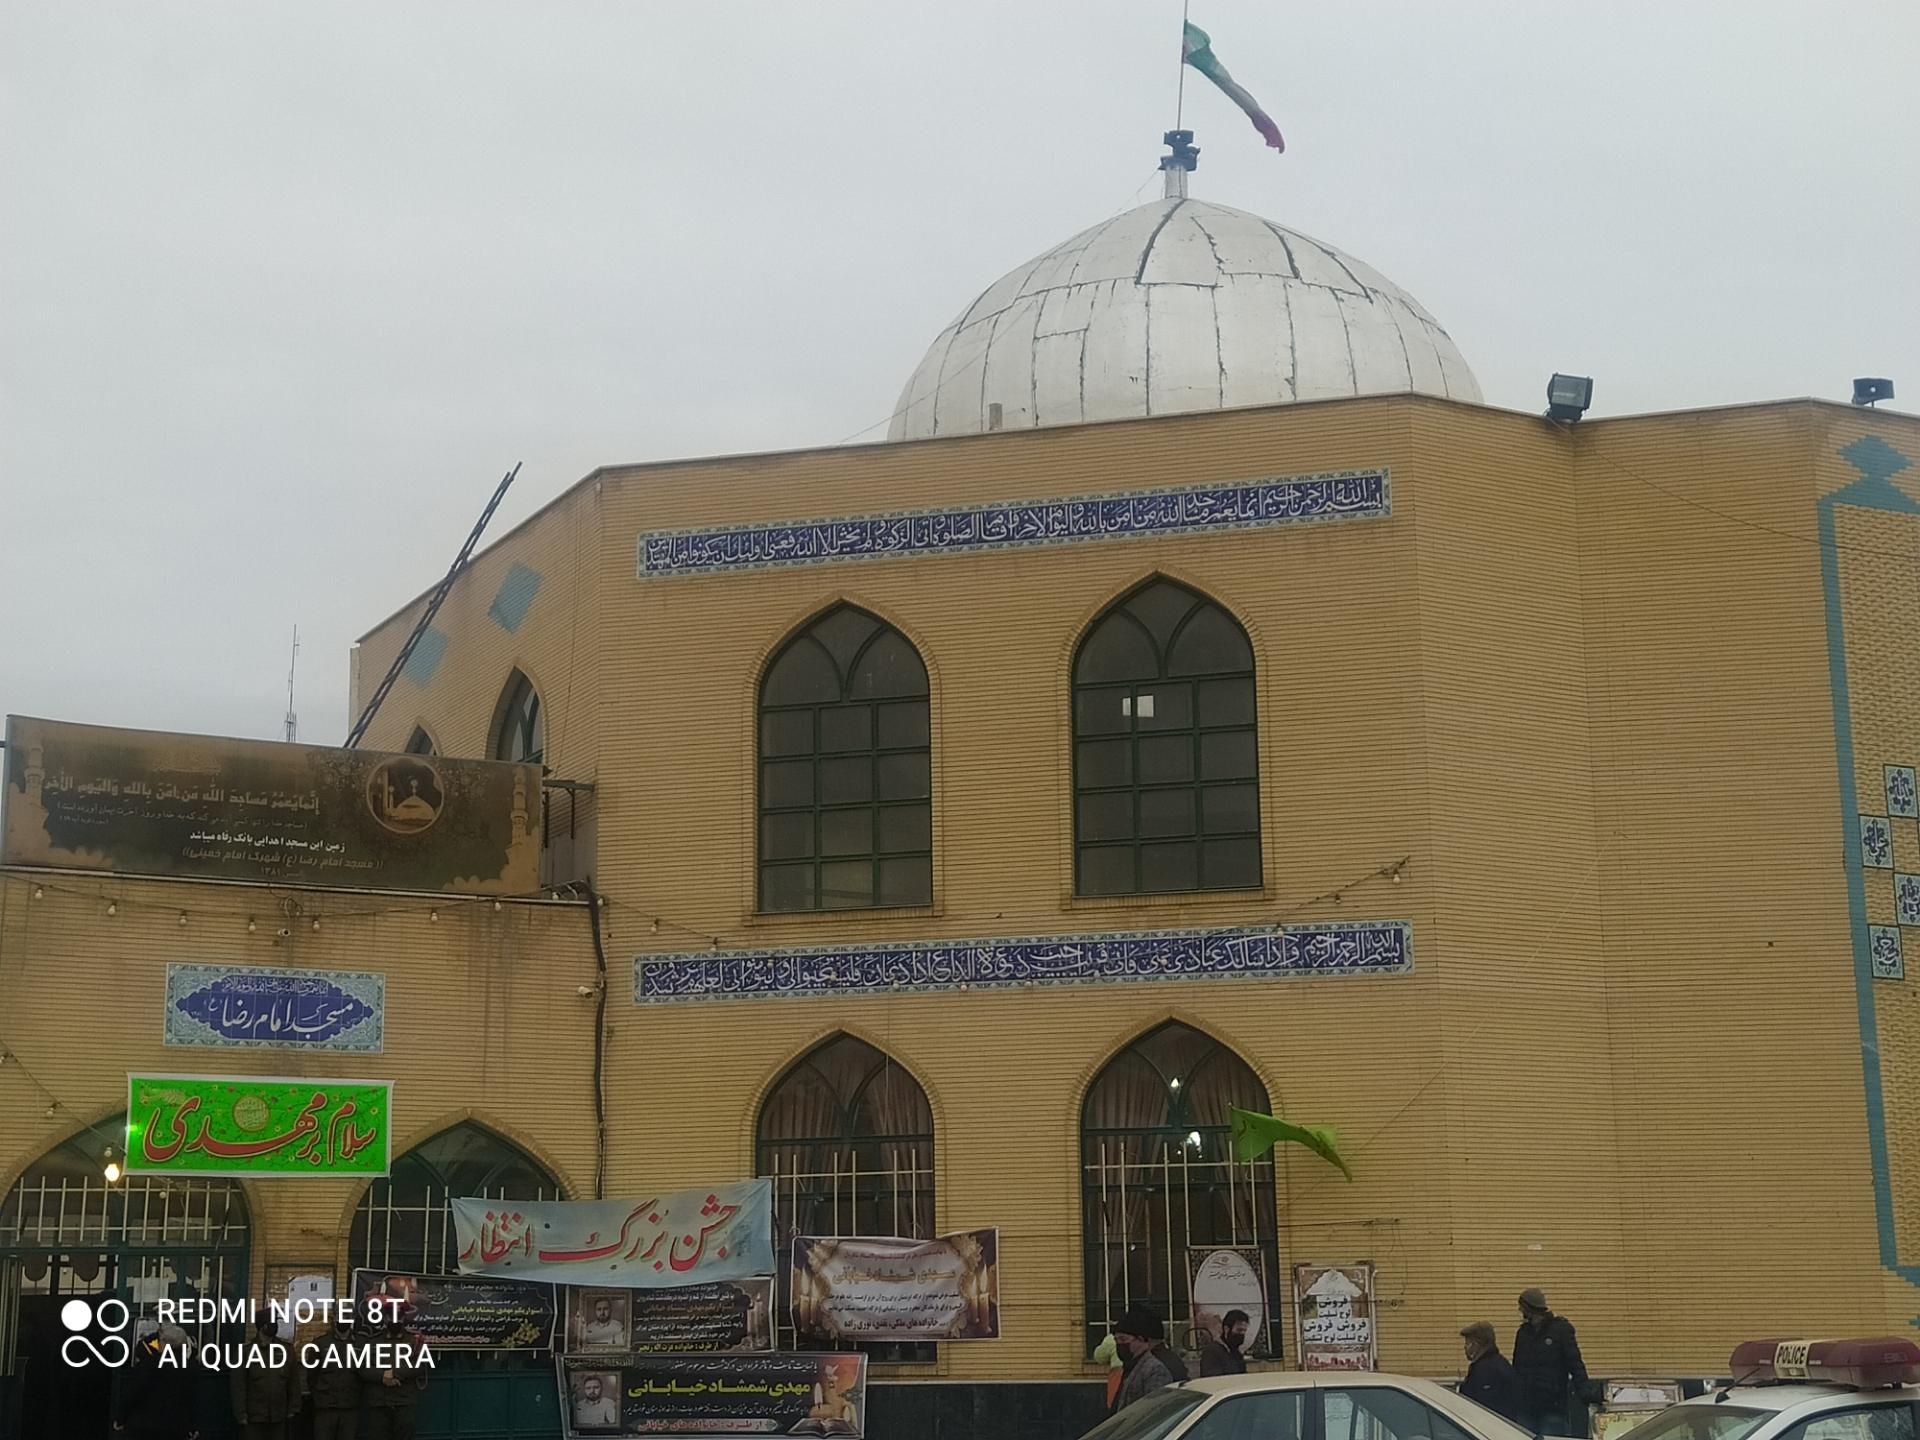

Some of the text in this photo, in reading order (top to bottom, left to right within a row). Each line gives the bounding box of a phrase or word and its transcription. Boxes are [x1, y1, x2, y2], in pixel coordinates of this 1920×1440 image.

[1289, 482, 1336, 516] الرحمن
[1336, 479, 1367, 503] الله
[1153, 496, 1182, 528] الله
[791, 527, 817, 556] الله
[233, 832, 253, 846] بانک
[286, 835, 307, 849] مسجد
[309, 839, 323, 850] این
[325, 841, 345, 852] زمین
[1329, 932, 1366, 966] الرحمن
[1366, 929, 1395, 949] الله
[222, 995, 255, 1030] رضا
[254, 998, 292, 1039] امام
[282, 1002, 354, 1040] مسجد
[143, 1091, 327, 1162] مهدی
[326, 1101, 377, 1166] سلام
[296, 1130, 322, 1166] بر
[458, 1193, 742, 1272] جشن بزرگ انتظار
[1318, 1296, 1349, 1309] فروش
[918, 1317, 938, 1328] خانواده
[1318, 1308, 1351, 1320] لوح تسلیت
[1304, 1319, 1367, 1332] فروش فروش
[699, 1342, 713, 1350] طرف
[1323, 1332, 1336, 1343] لوح
[1336, 1332, 1357, 1341] تسلیت
[1358, 1332, 1369, 1343] لوح
[1776, 1345, 1807, 1365] POLICE
[627, 1377, 812, 1398] مهدی شمشاد خیابانی
[690, 1420, 719, 1430] خانواده
[726, 1419, 752, 1430] طرف
